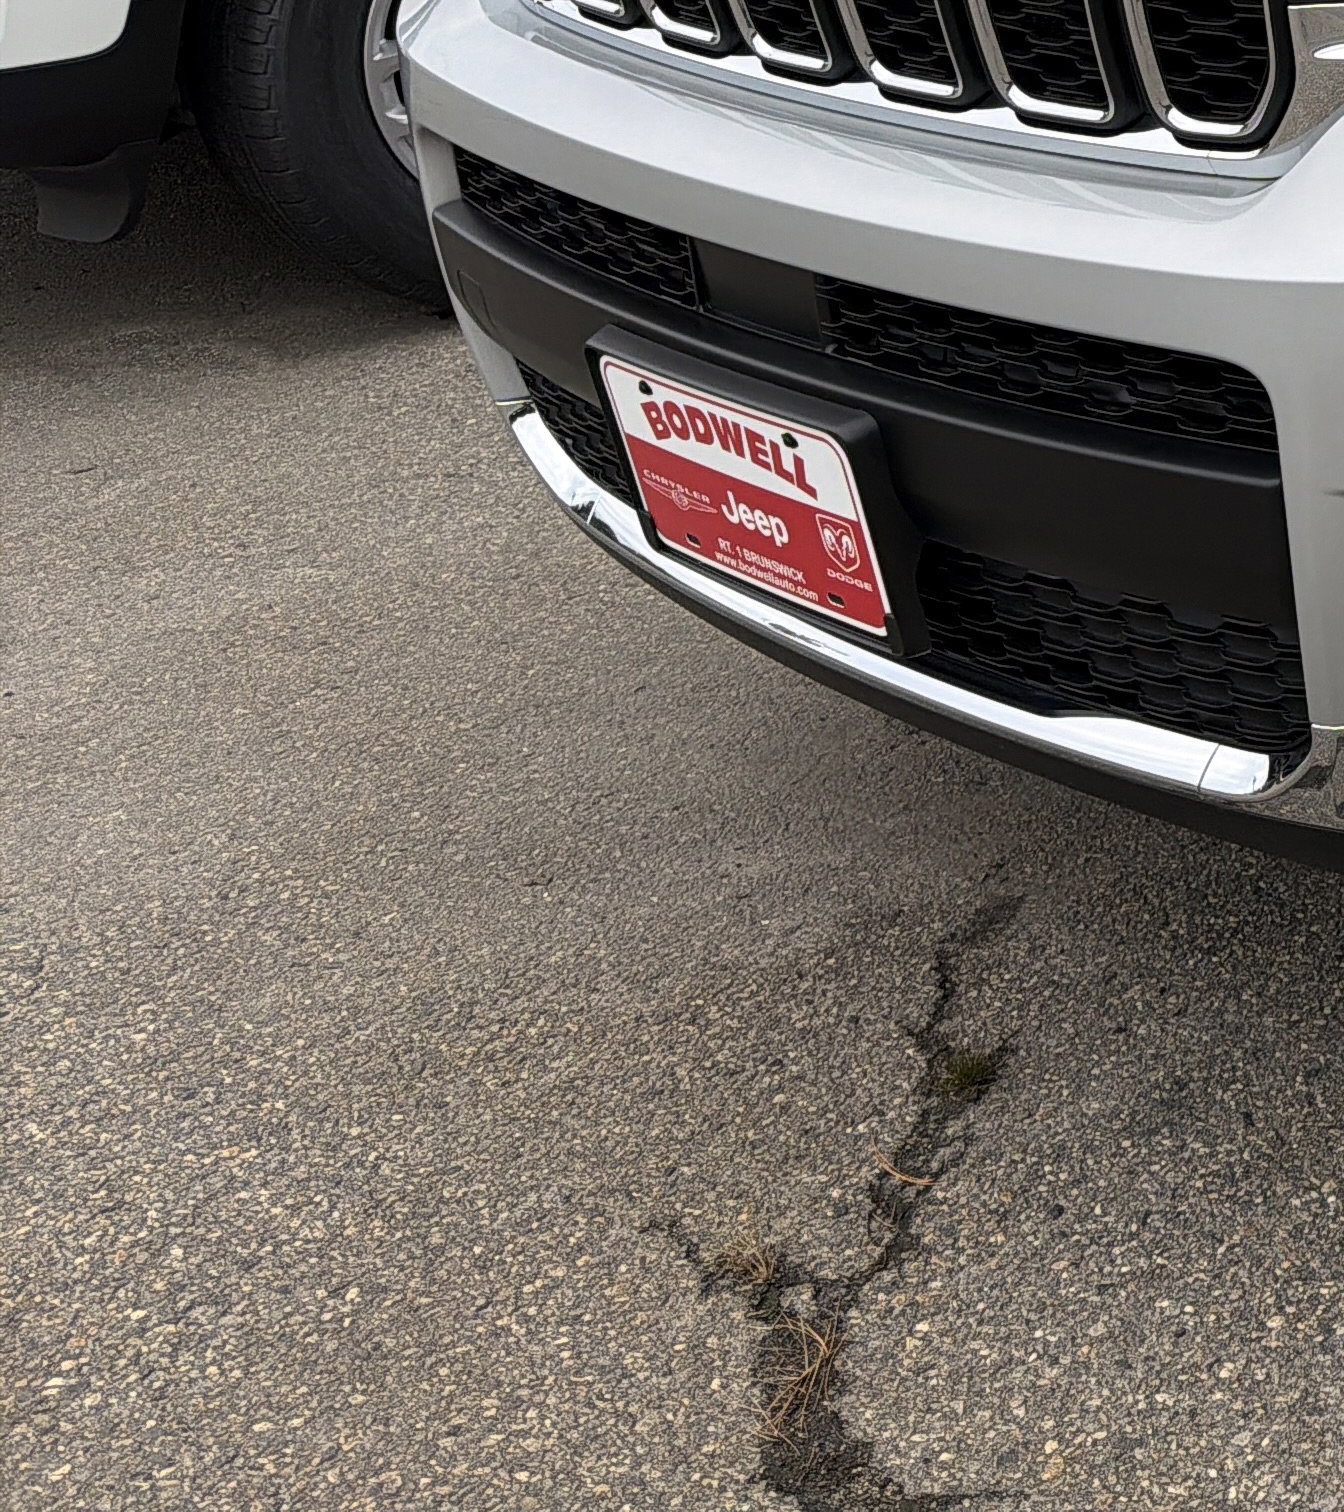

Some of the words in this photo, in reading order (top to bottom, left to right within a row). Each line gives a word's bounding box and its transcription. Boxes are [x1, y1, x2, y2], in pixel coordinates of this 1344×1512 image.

[640, 400, 818, 502] BODWELL
[642, 468, 711, 505] CHRYSLER
[720, 490, 790, 548] Jeep
[718, 537, 736, 555] RT.
[736, 545, 743, 558] 1
[714, 551, 819, 602] www.bodwellauto.com
[826, 567, 874, 593] DODGE
